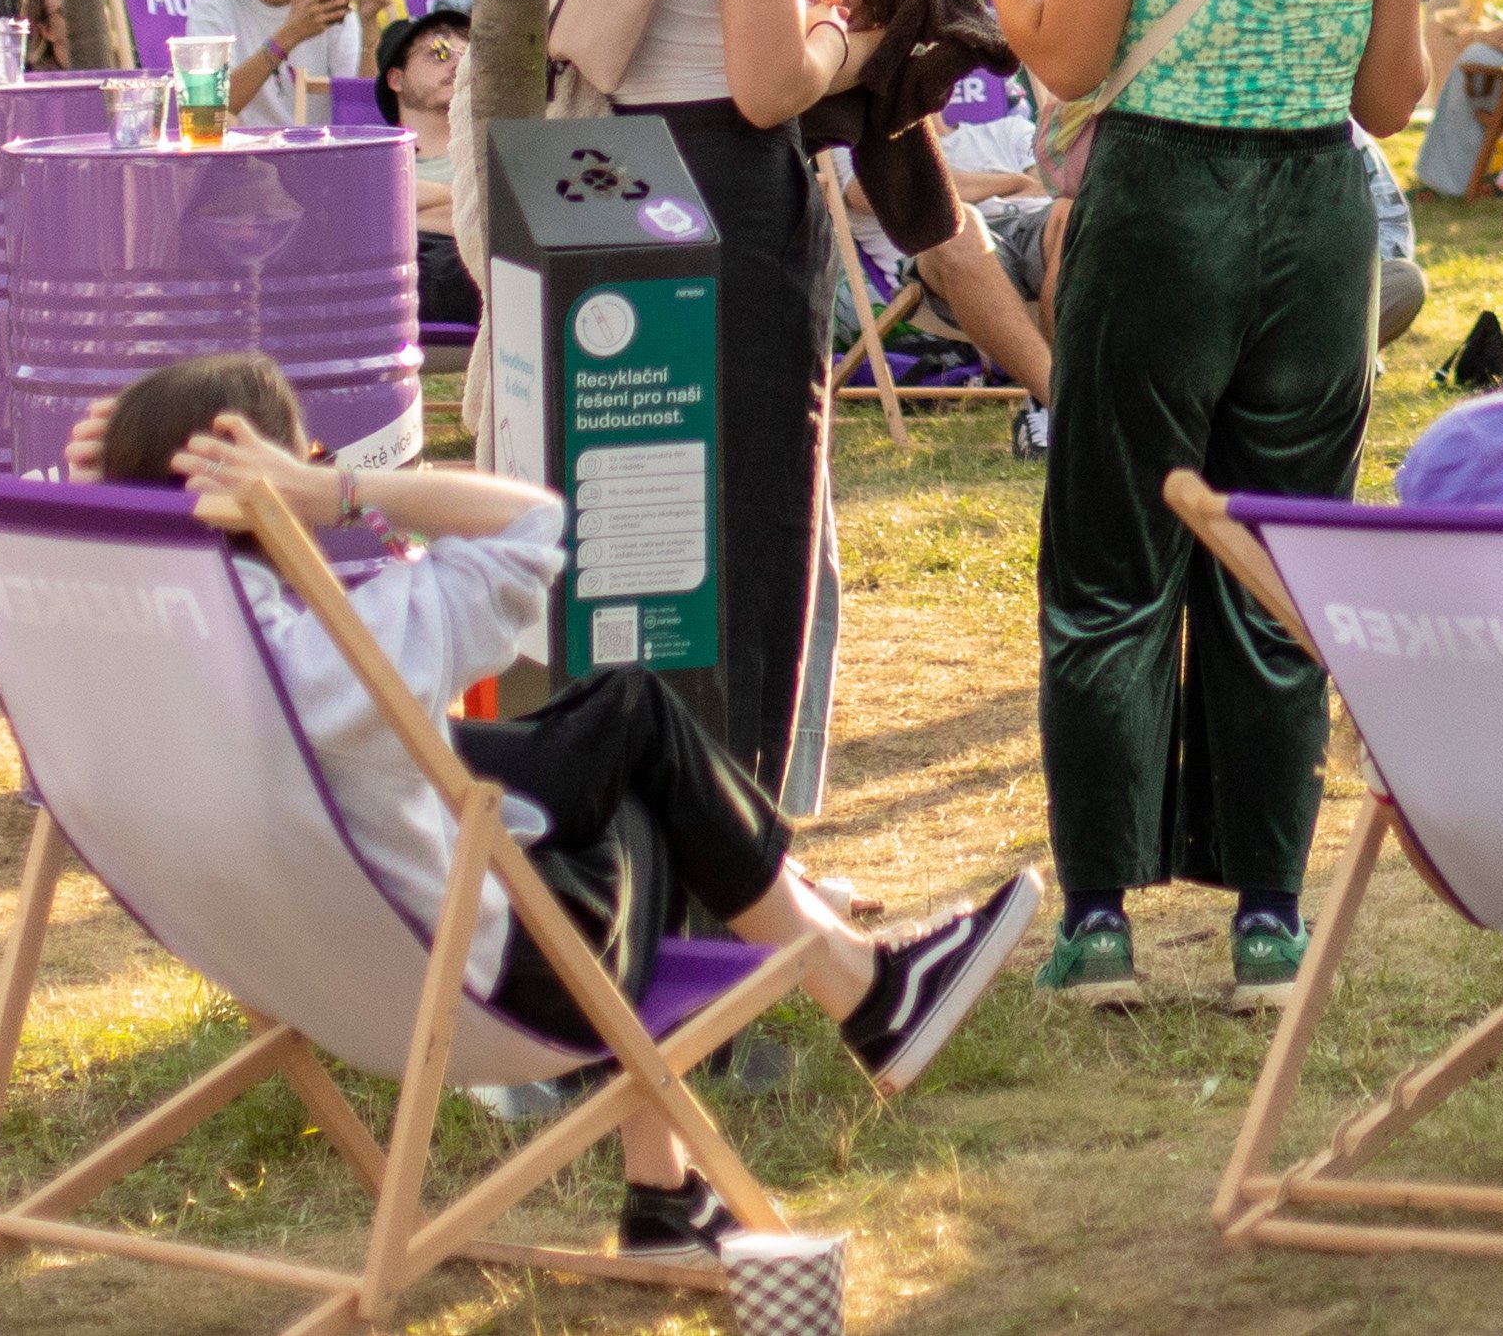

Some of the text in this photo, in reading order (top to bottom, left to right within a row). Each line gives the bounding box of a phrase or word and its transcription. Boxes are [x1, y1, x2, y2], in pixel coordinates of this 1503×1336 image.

[576, 366, 669, 391] Recyklační
[576, 384, 702, 410] řešení pro naši
[576, 408, 685, 431] budoucnost.
